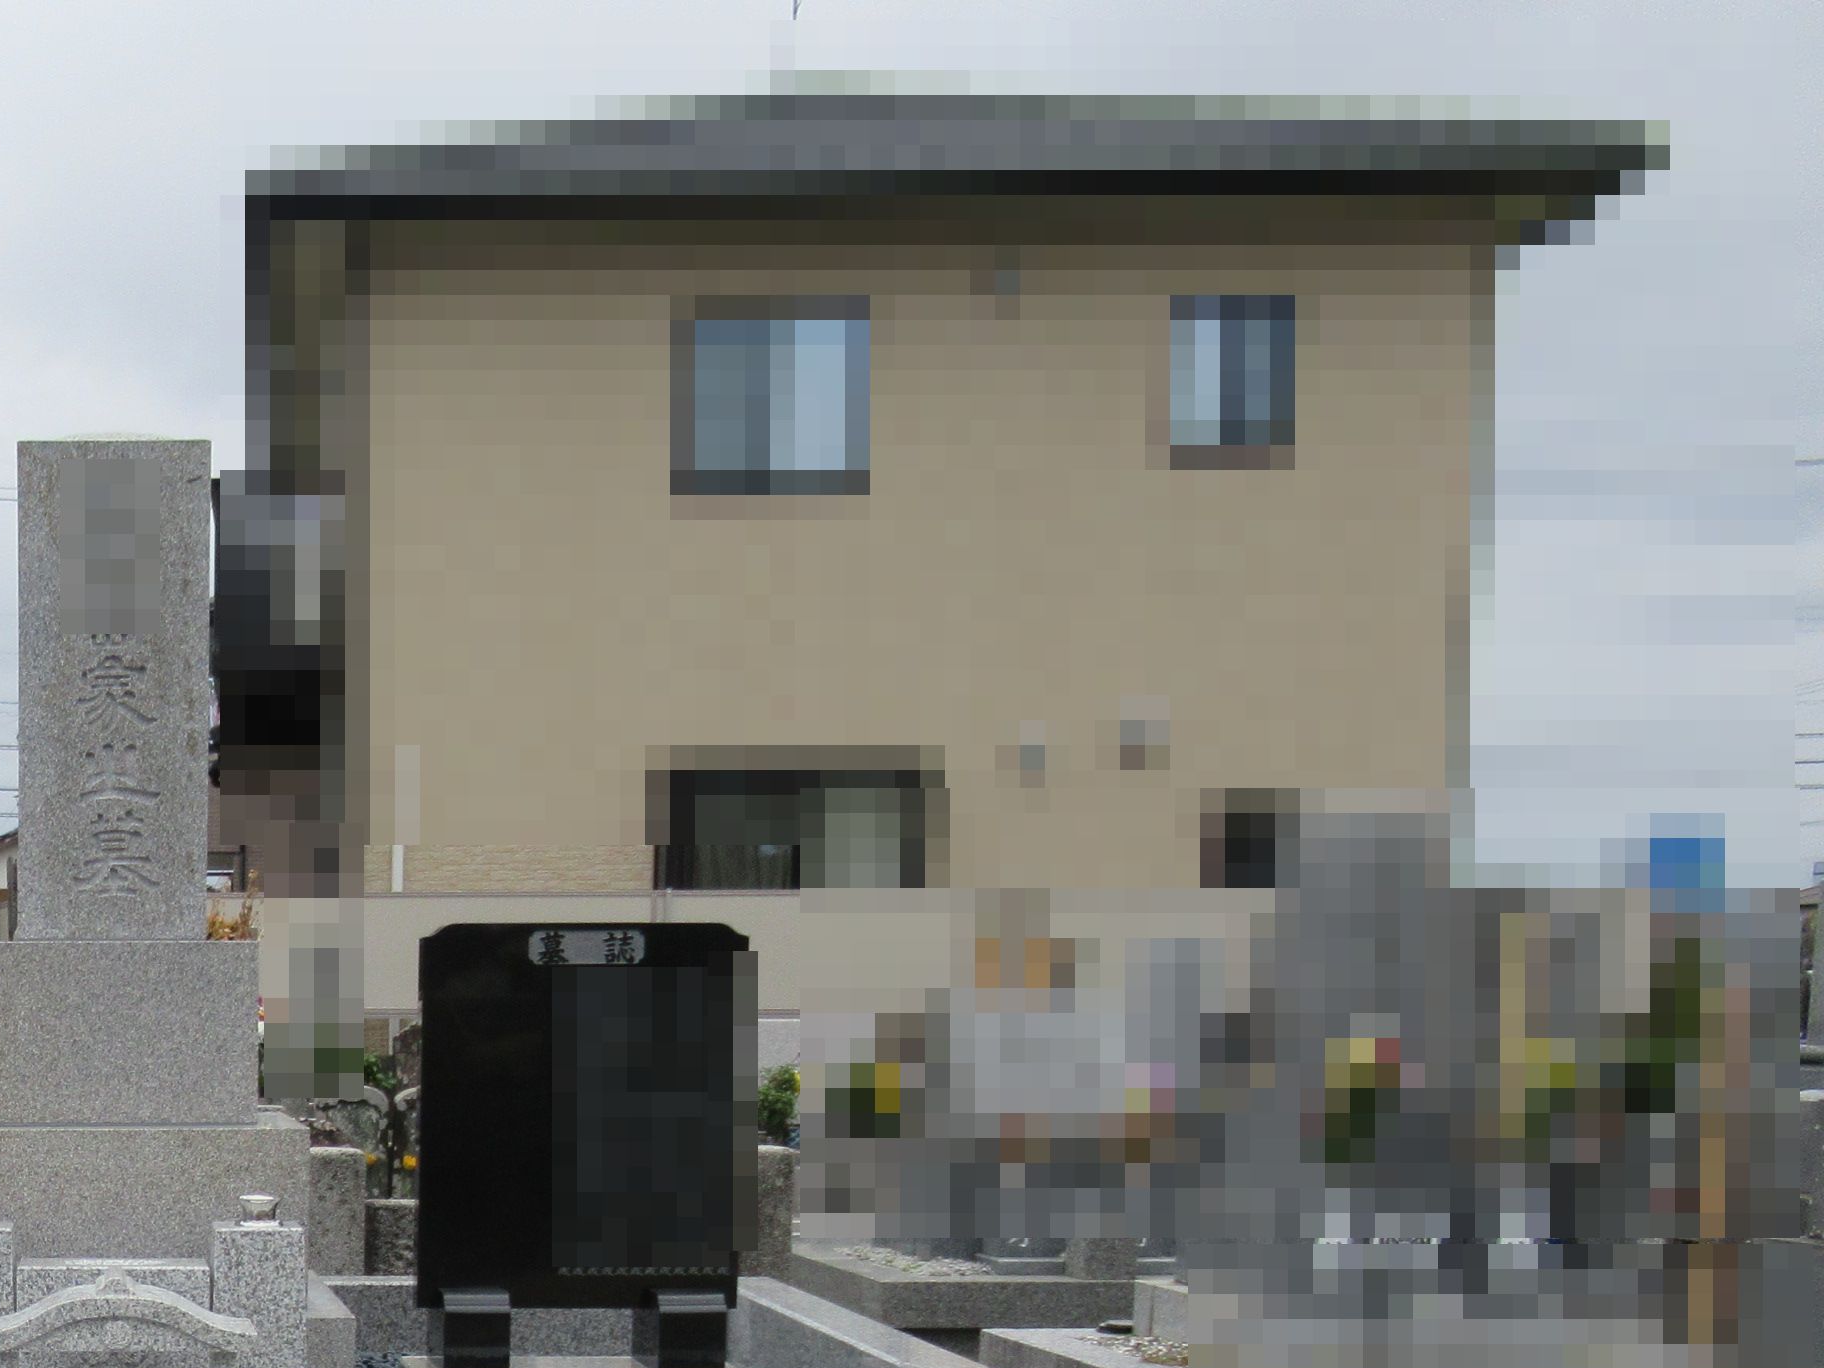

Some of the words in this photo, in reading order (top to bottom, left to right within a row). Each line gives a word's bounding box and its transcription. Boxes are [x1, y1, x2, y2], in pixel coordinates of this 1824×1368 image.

[74, 635, 161, 897] 家之墓
[537, 931, 635, 963] 墓誌
